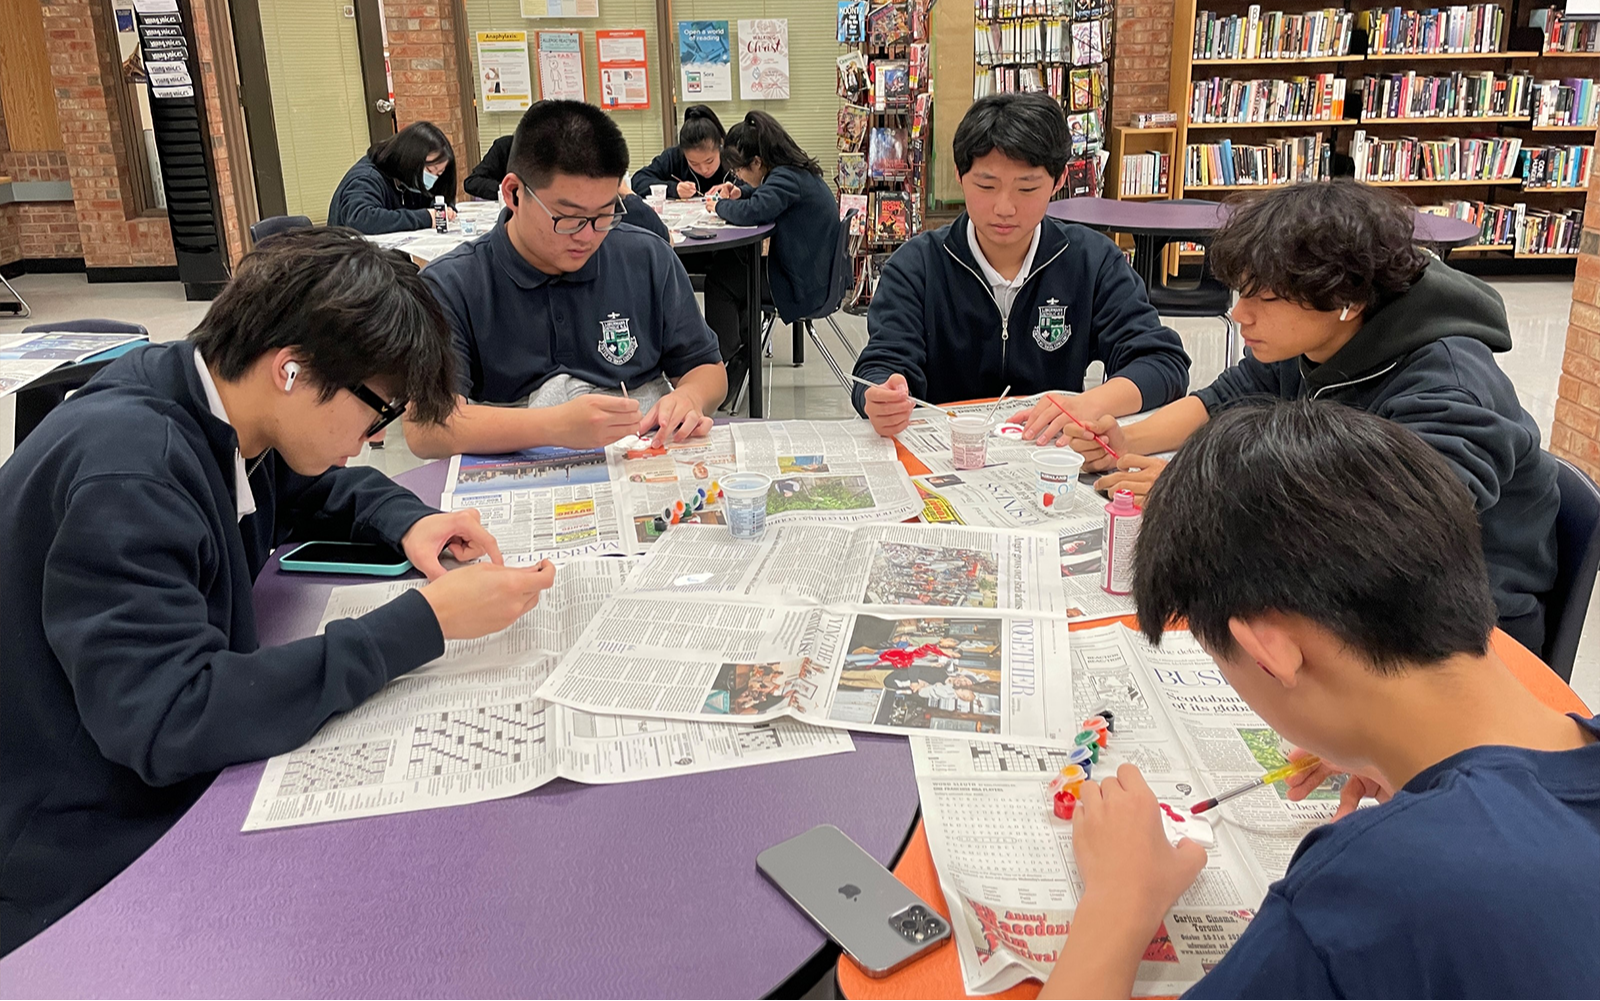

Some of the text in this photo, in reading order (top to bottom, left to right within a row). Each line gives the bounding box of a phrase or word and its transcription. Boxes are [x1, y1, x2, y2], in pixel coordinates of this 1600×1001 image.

[747, 39, 781, 53] Christ
[1011, 619, 1036, 697] TOGETHER
[1190, 703, 1209, 712] its
[1285, 802, 1318, 811] Uber
[1005, 910, 1047, 922] Annual
[1173, 914, 1203, 923] Carlton
[1192, 923, 1224, 932] Toronto
